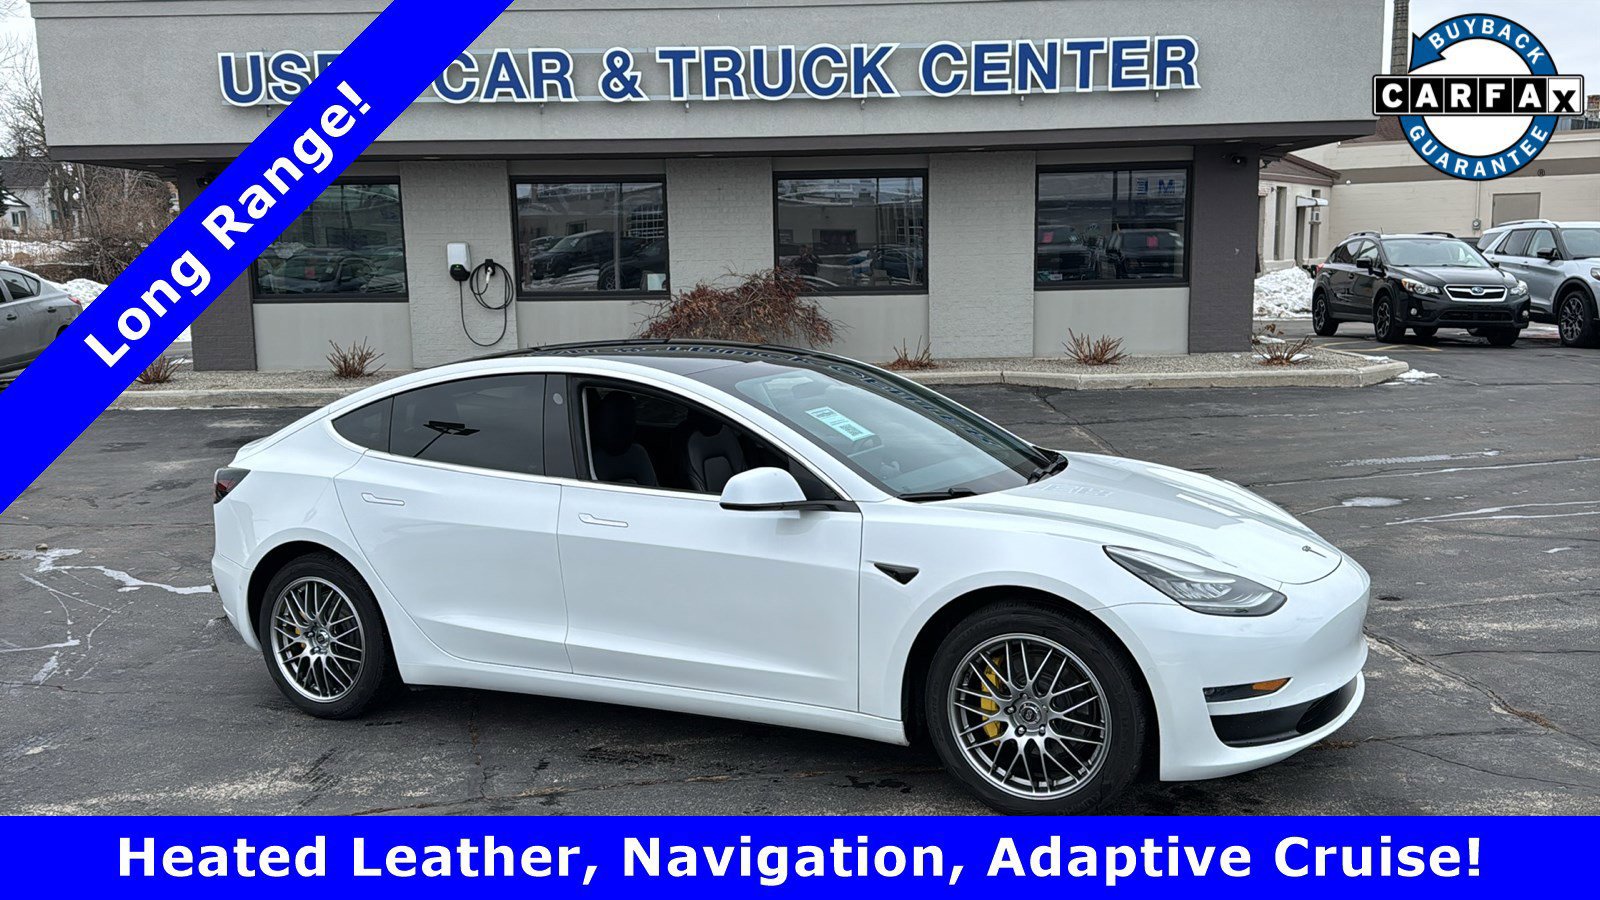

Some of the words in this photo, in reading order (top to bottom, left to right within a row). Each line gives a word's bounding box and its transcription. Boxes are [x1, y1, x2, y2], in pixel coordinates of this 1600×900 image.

[432, 48, 579, 104] CAR
[598, 46, 649, 103] &
[655, 42, 901, 103] TRUCK
[919, 34, 1201, 99] CENTER
